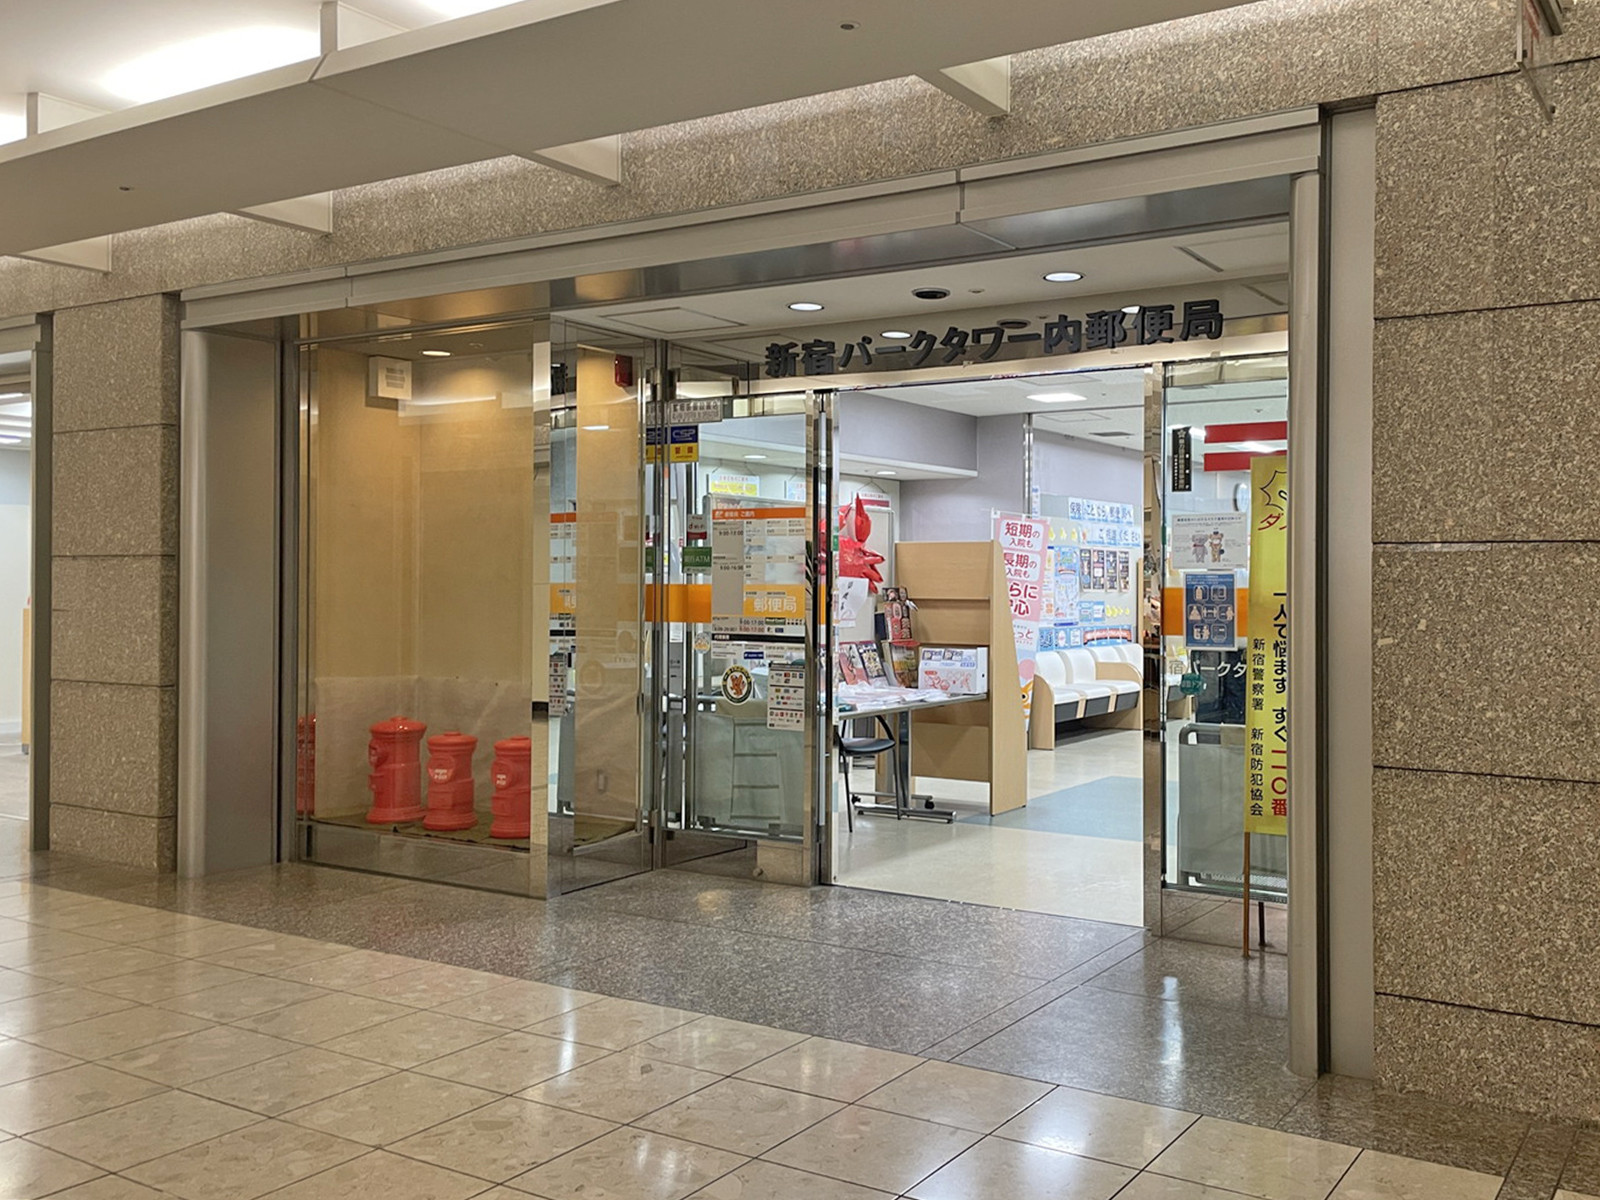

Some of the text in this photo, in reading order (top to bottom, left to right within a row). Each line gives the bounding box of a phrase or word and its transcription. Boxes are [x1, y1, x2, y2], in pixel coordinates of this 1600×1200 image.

[765, 299, 1222, 377] 新宿パークタワー内郵便局
[1004, 522, 1040, 538] 短期の
[1009, 539, 1033, 548] 入院も
[1006, 568, 1030, 578] 入院も
[754, 596, 796, 613] 郵便局
[1250, 638, 1265, 816] 新宿警察署 新宿防犯協会
